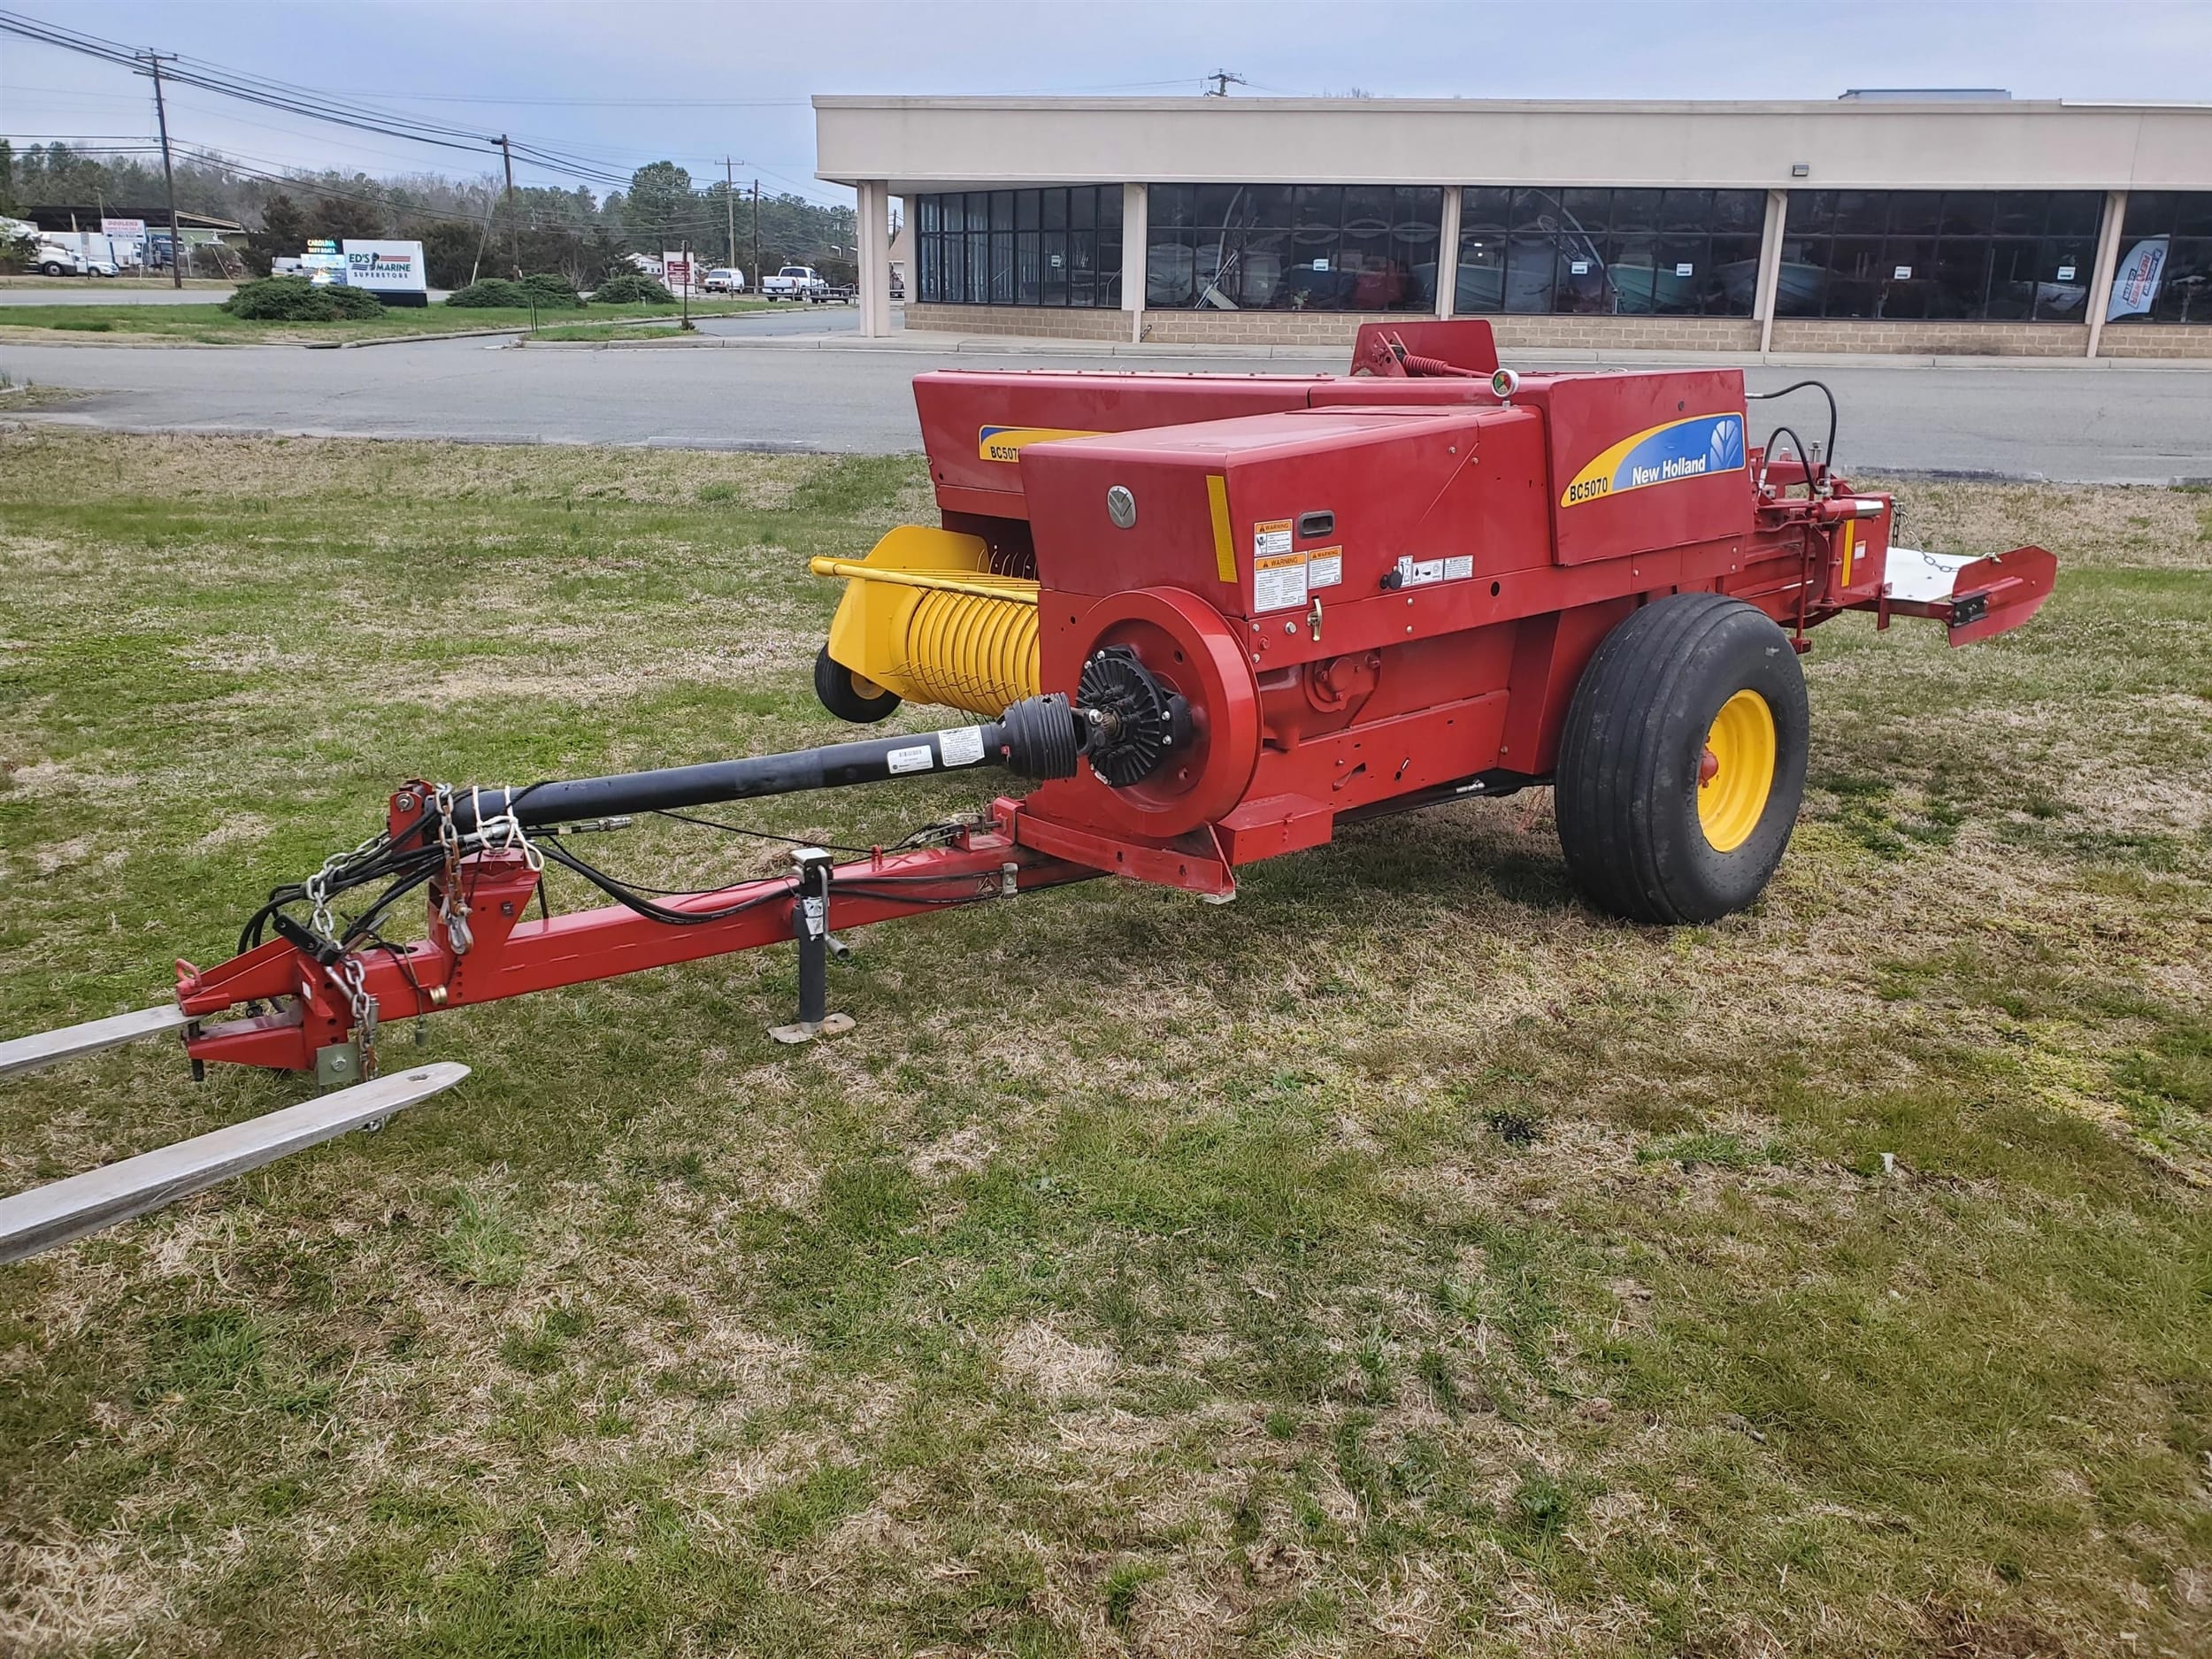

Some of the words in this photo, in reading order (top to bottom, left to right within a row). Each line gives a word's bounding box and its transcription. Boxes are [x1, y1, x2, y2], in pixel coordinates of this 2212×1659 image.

[349, 253, 370, 264] ED'S
[376, 264, 411, 273] MARINE
[990, 446, 1019, 460] BC507
[1632, 465, 1659, 487] New
[1663, 454, 1706, 480] Holland
[1570, 476, 1608, 502] BC5070
[1317, 549, 1339, 557] WARNING
[1271, 557, 1298, 566] WARNING
